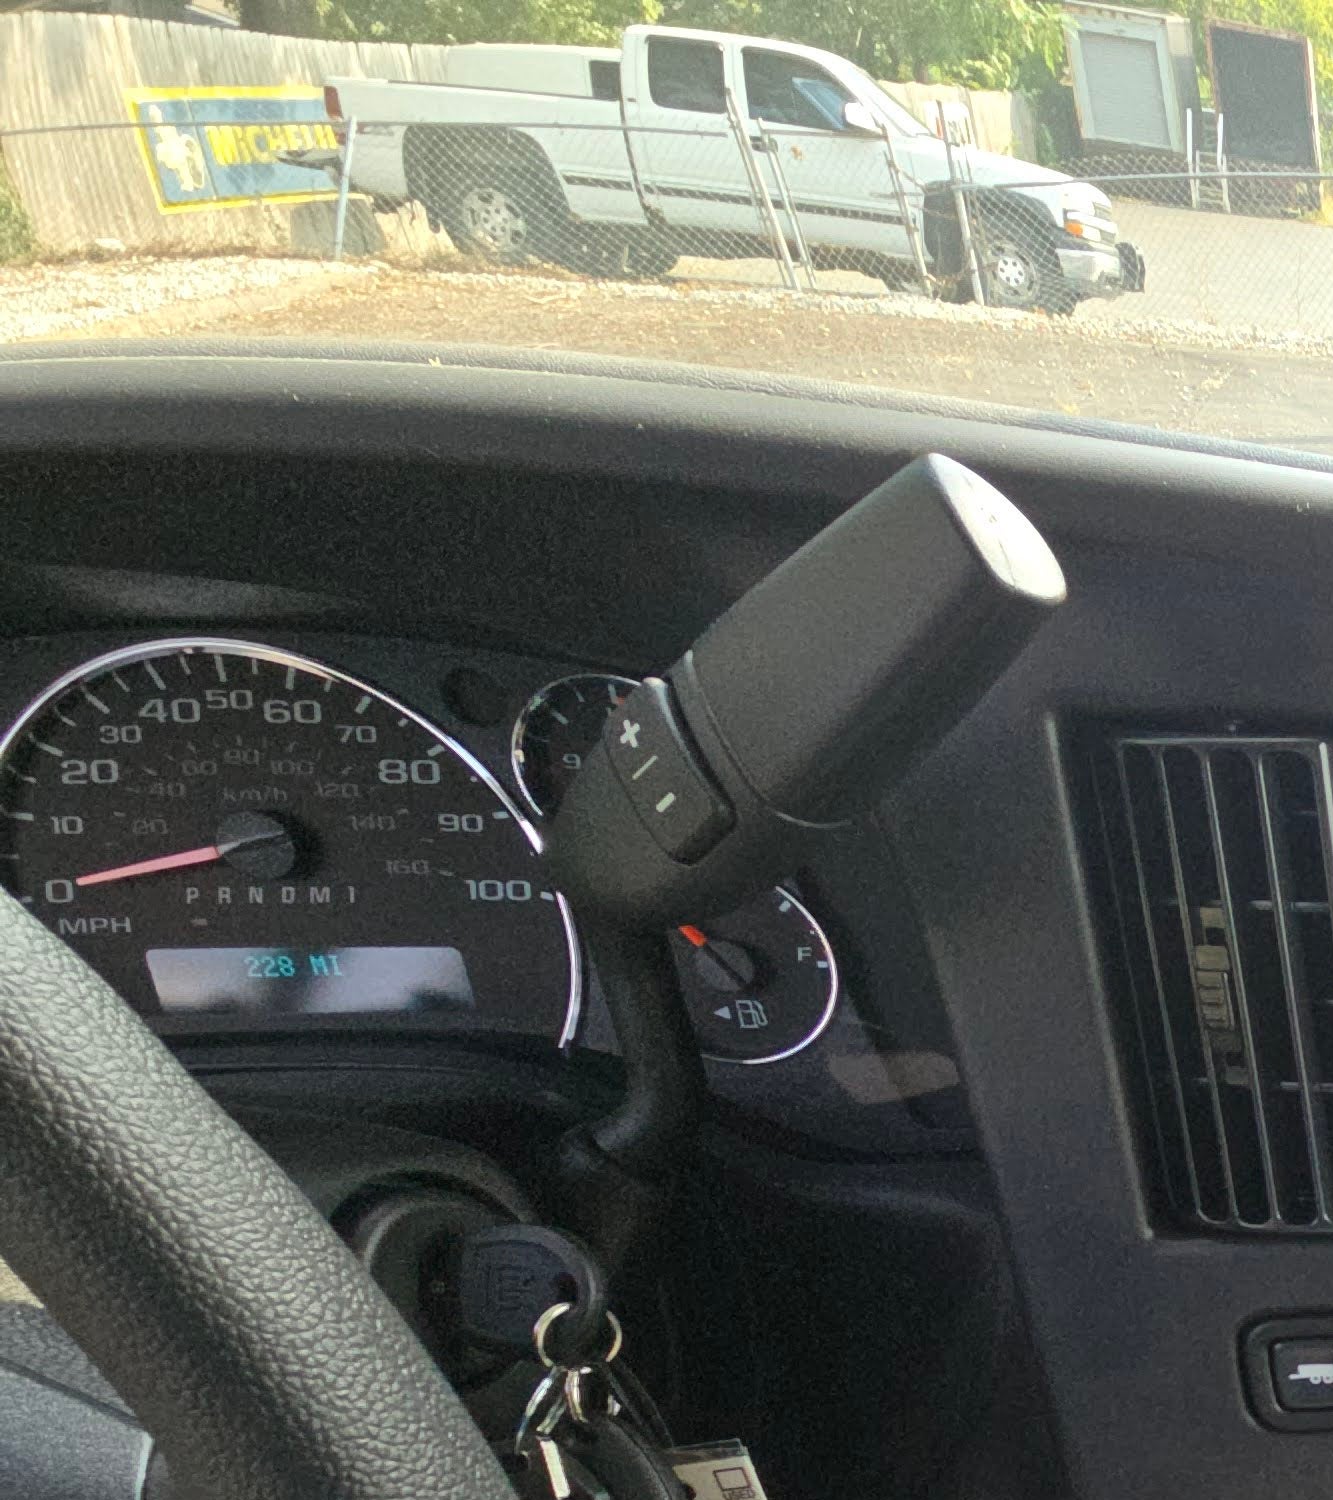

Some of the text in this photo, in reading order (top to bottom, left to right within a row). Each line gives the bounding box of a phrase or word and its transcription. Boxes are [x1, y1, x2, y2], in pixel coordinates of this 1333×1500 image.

[205, 689, 253, 710] 50
[139, 698, 200, 723] 40
[263, 699, 322, 724] 60
[99, 725, 142, 744] 30
[335, 725, 377, 743] 70
[60, 759, 119, 785] 20
[378, 759, 441, 785] 80
[51, 815, 84, 834] 10
[437, 813, 484, 833] 90
[45, 880, 74, 902] 0
[186, 886, 199, 904] P
[217, 886, 232, 904] R
[249, 886, 264, 904] N
[309, 886, 331, 904] M
[465, 879, 532, 901] 100
[59, 917, 132, 934] MPH
[797, 946, 812, 962] F
[243, 954, 343, 978] 228 MI
